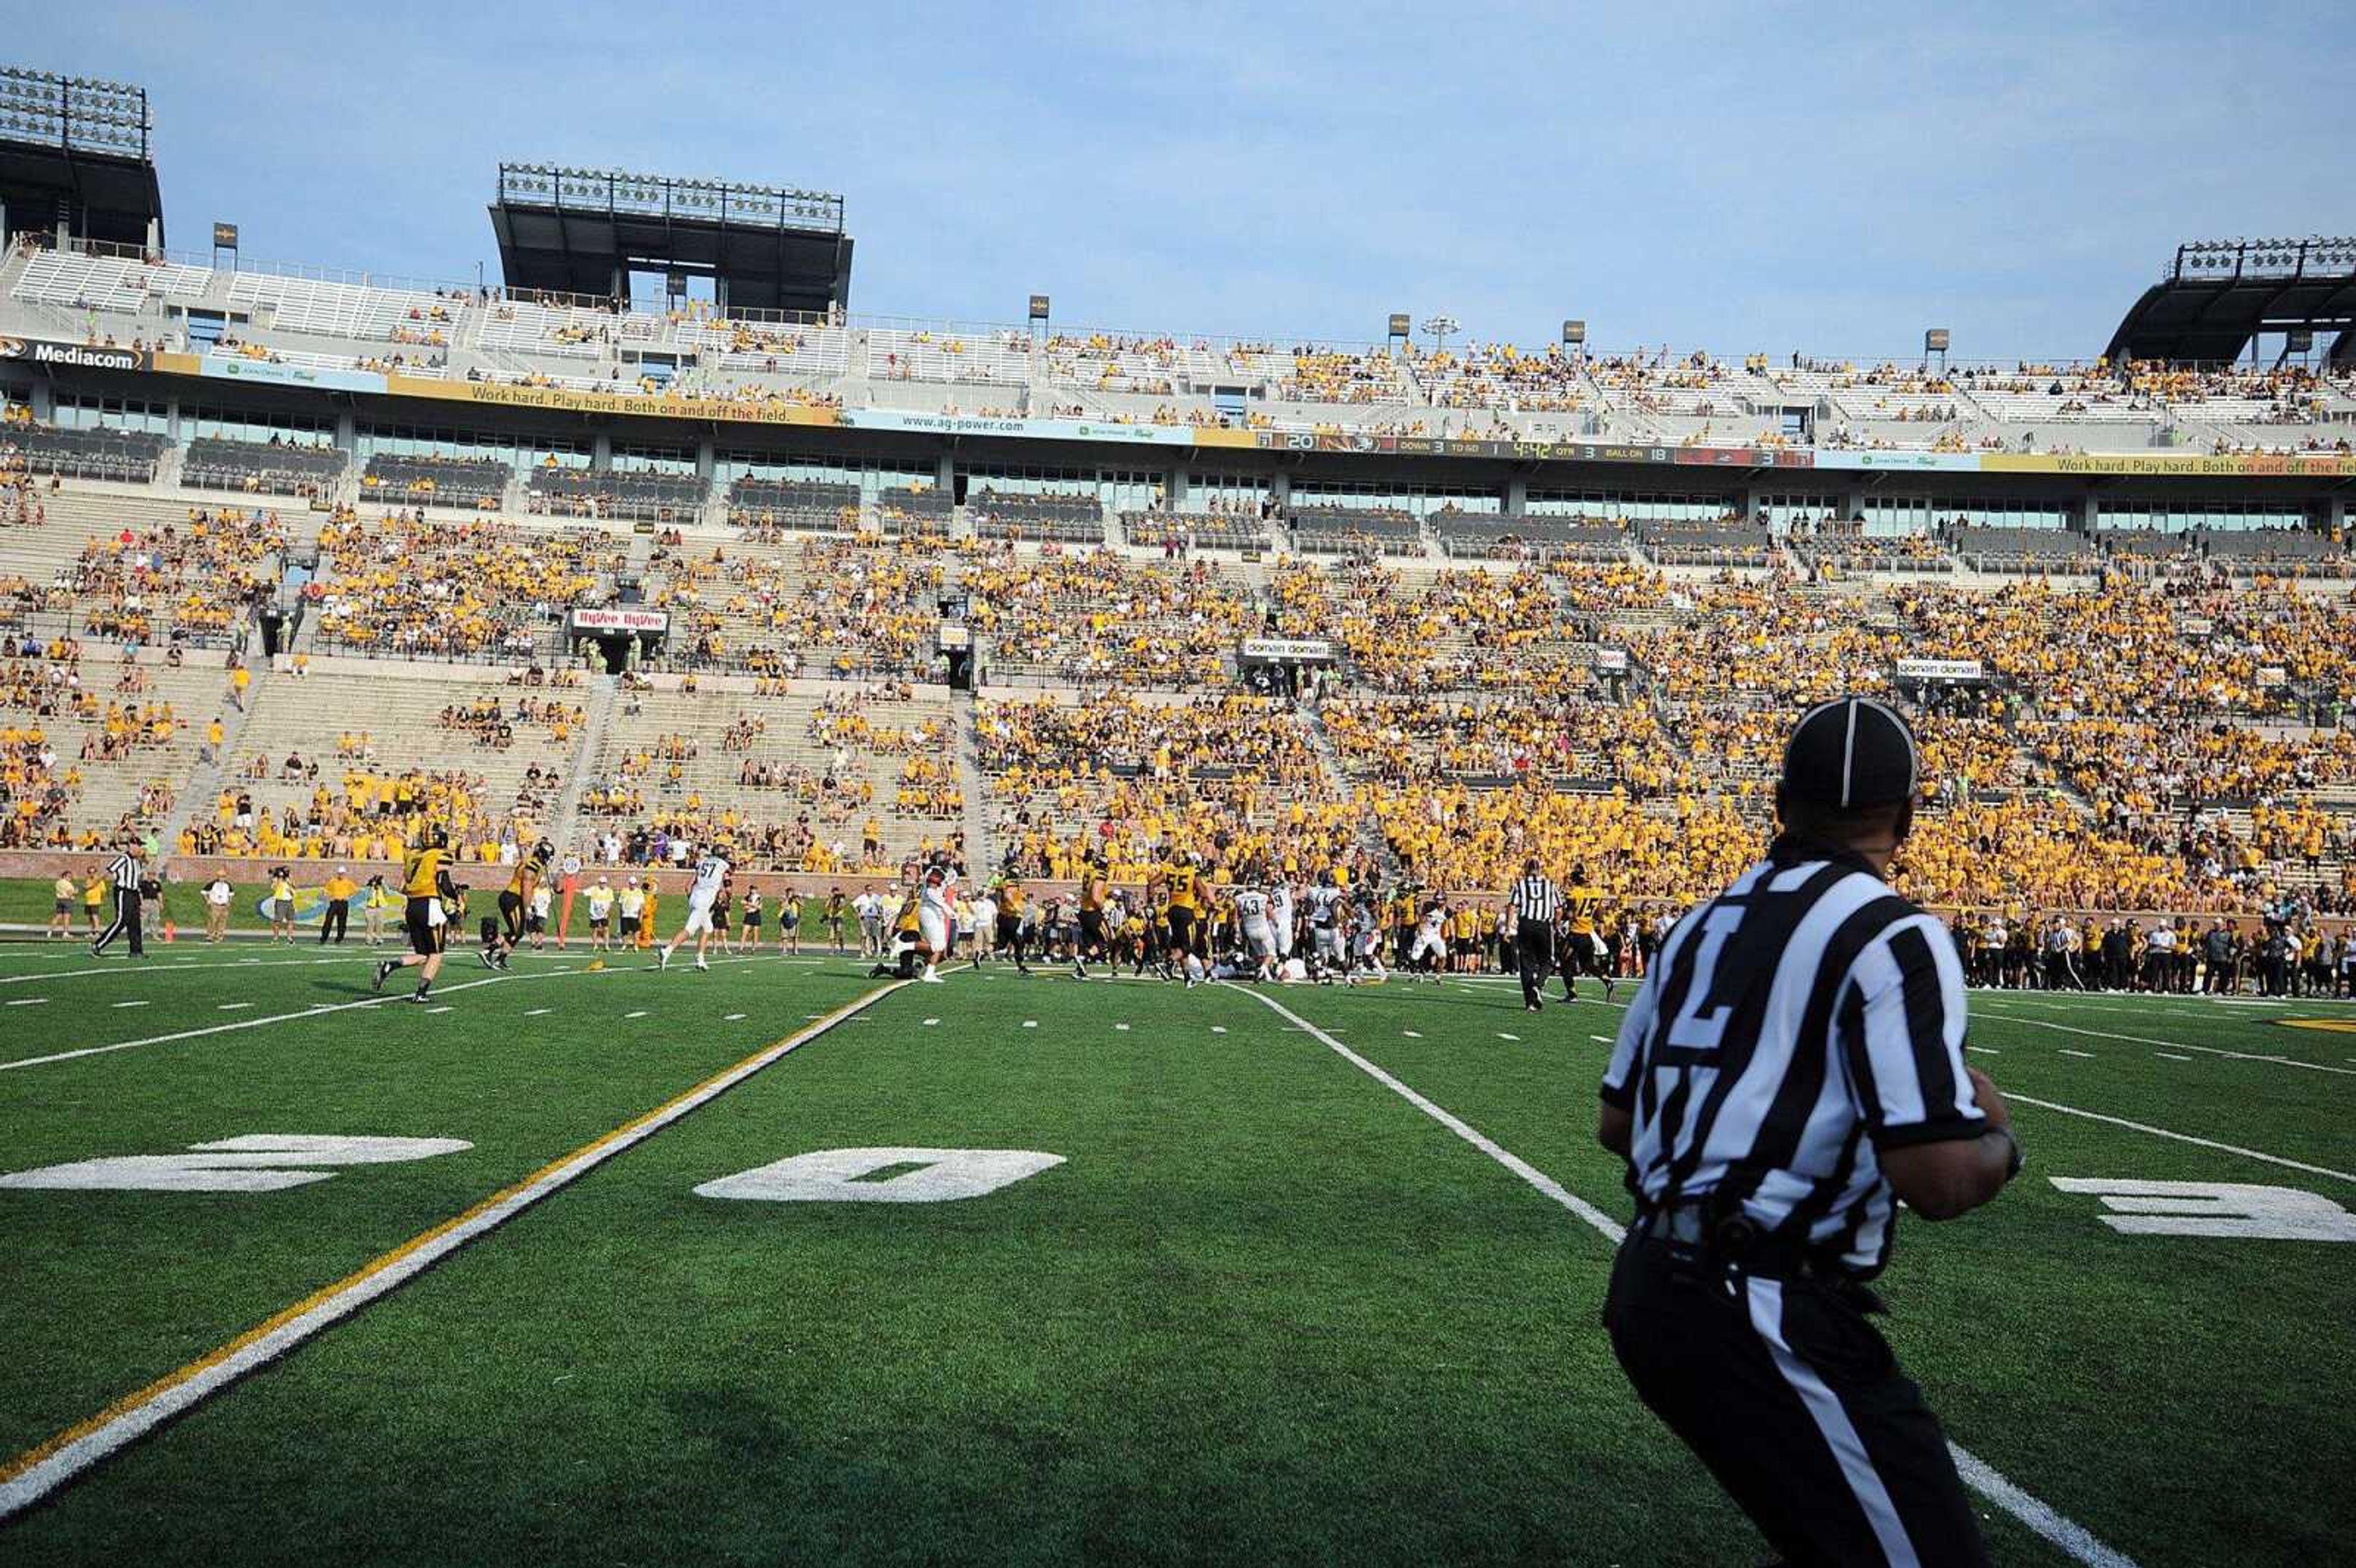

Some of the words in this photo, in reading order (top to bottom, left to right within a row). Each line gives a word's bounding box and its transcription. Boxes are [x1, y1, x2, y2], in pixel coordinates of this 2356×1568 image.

[35, 345, 133, 369] Mediacom
[472, 386, 509, 400] Work
[513, 392, 547, 405] hard.
[553, 394, 582, 408] Play
[585, 398, 620, 410] hard.
[625, 399, 655, 412] Both
[660, 405, 676, 413] on
[680, 403, 704, 417] and
[709, 405, 728, 418] off
[732, 407, 752, 420] the
[757, 408, 790, 421] field.
[903, 417, 1024, 431] www.ag-power.com
[1288, 434, 1314, 449] 20
[1584, 447, 1595, 459] 3
[2058, 459, 2090, 471] Work
[2095, 459, 2128, 472] hard.
[2133, 461, 2159, 474] Play
[2165, 461, 2198, 472] hard.
[2203, 461, 2233, 472] Both
[2258, 461, 2282, 472] and
[2287, 461, 2306, 472] off
[2311, 461, 2332, 472] the
[701, 863, 717, 878] 57
[1166, 873, 1188, 892] 55
[1243, 899, 1259, 915] 43
